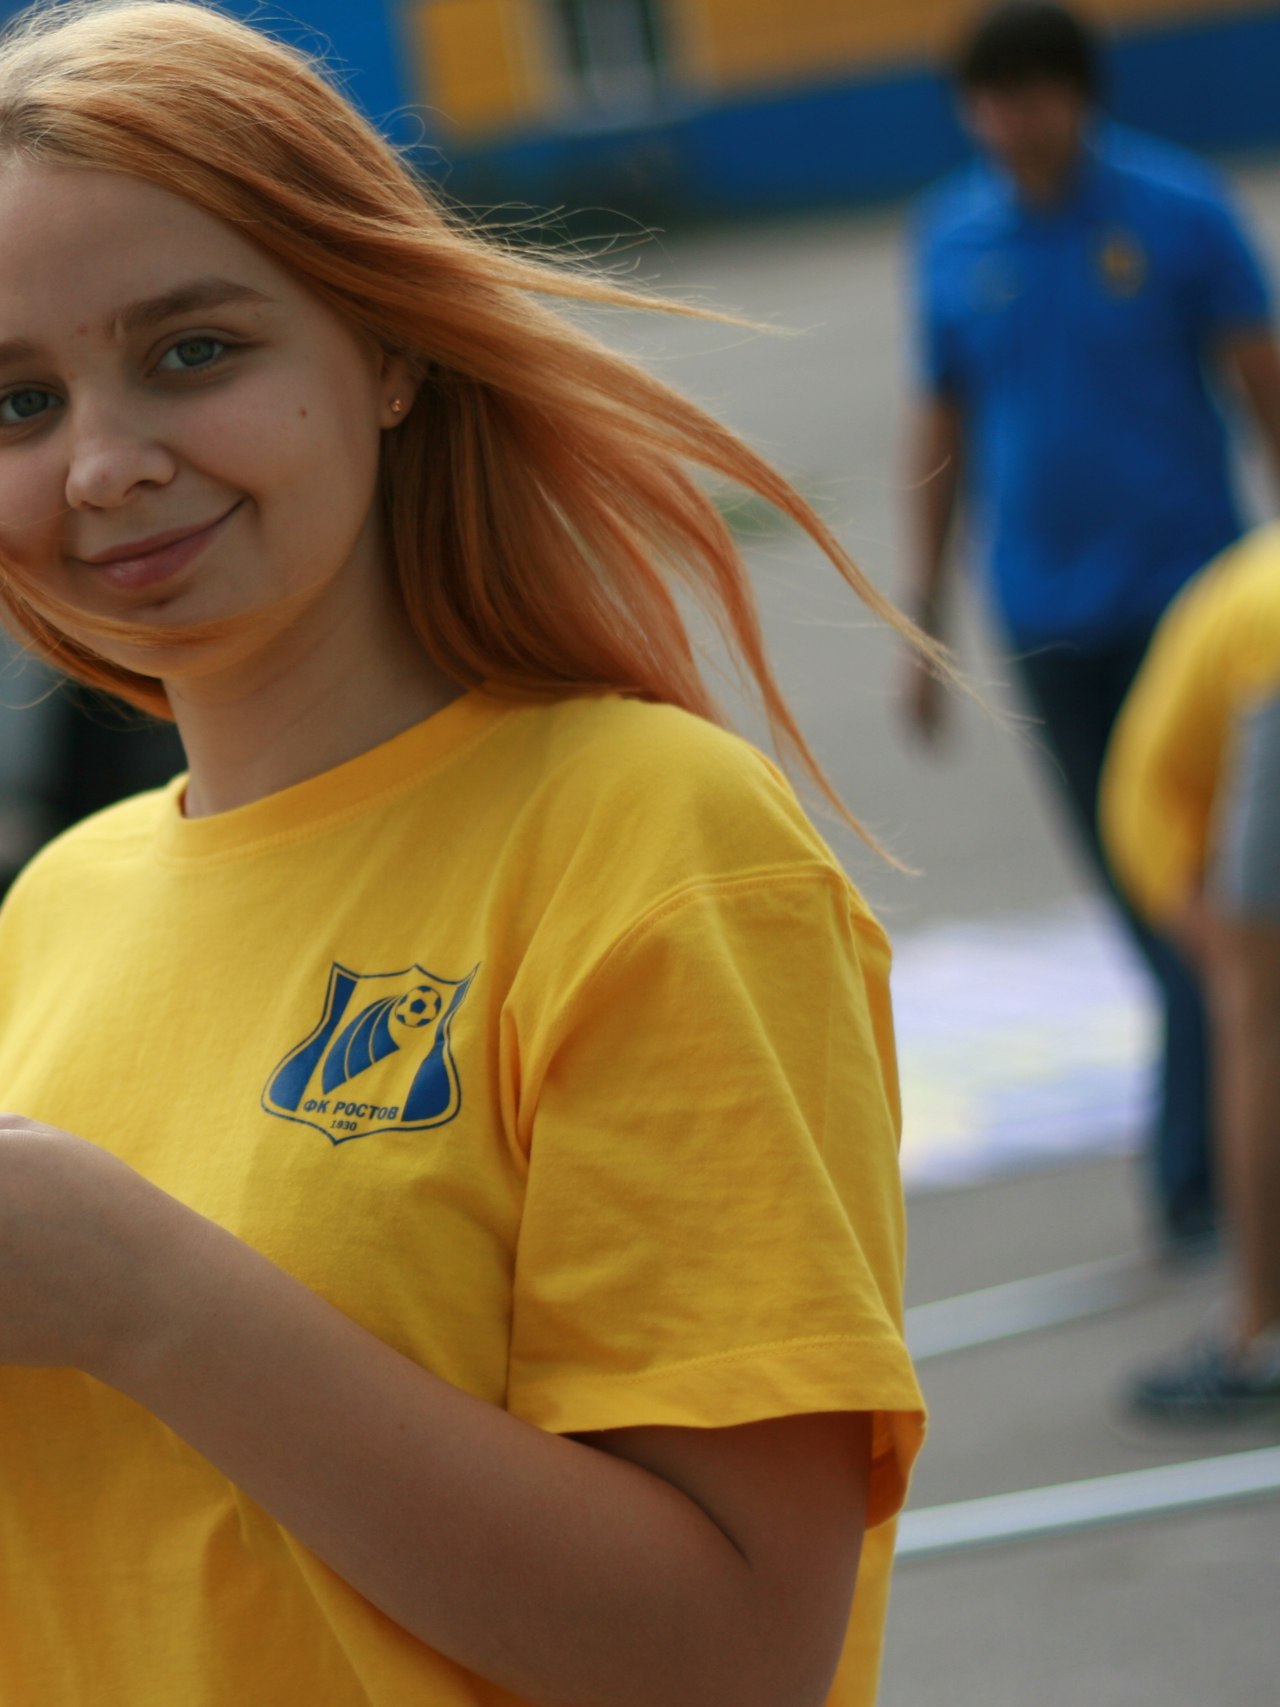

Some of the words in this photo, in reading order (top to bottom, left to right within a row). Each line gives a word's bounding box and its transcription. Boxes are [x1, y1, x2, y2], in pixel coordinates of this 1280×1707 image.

[303, 1100, 330, 1114] ФК
[333, 1101, 399, 1120] РОСТОВ
[330, 1120, 357, 1131] 1930
